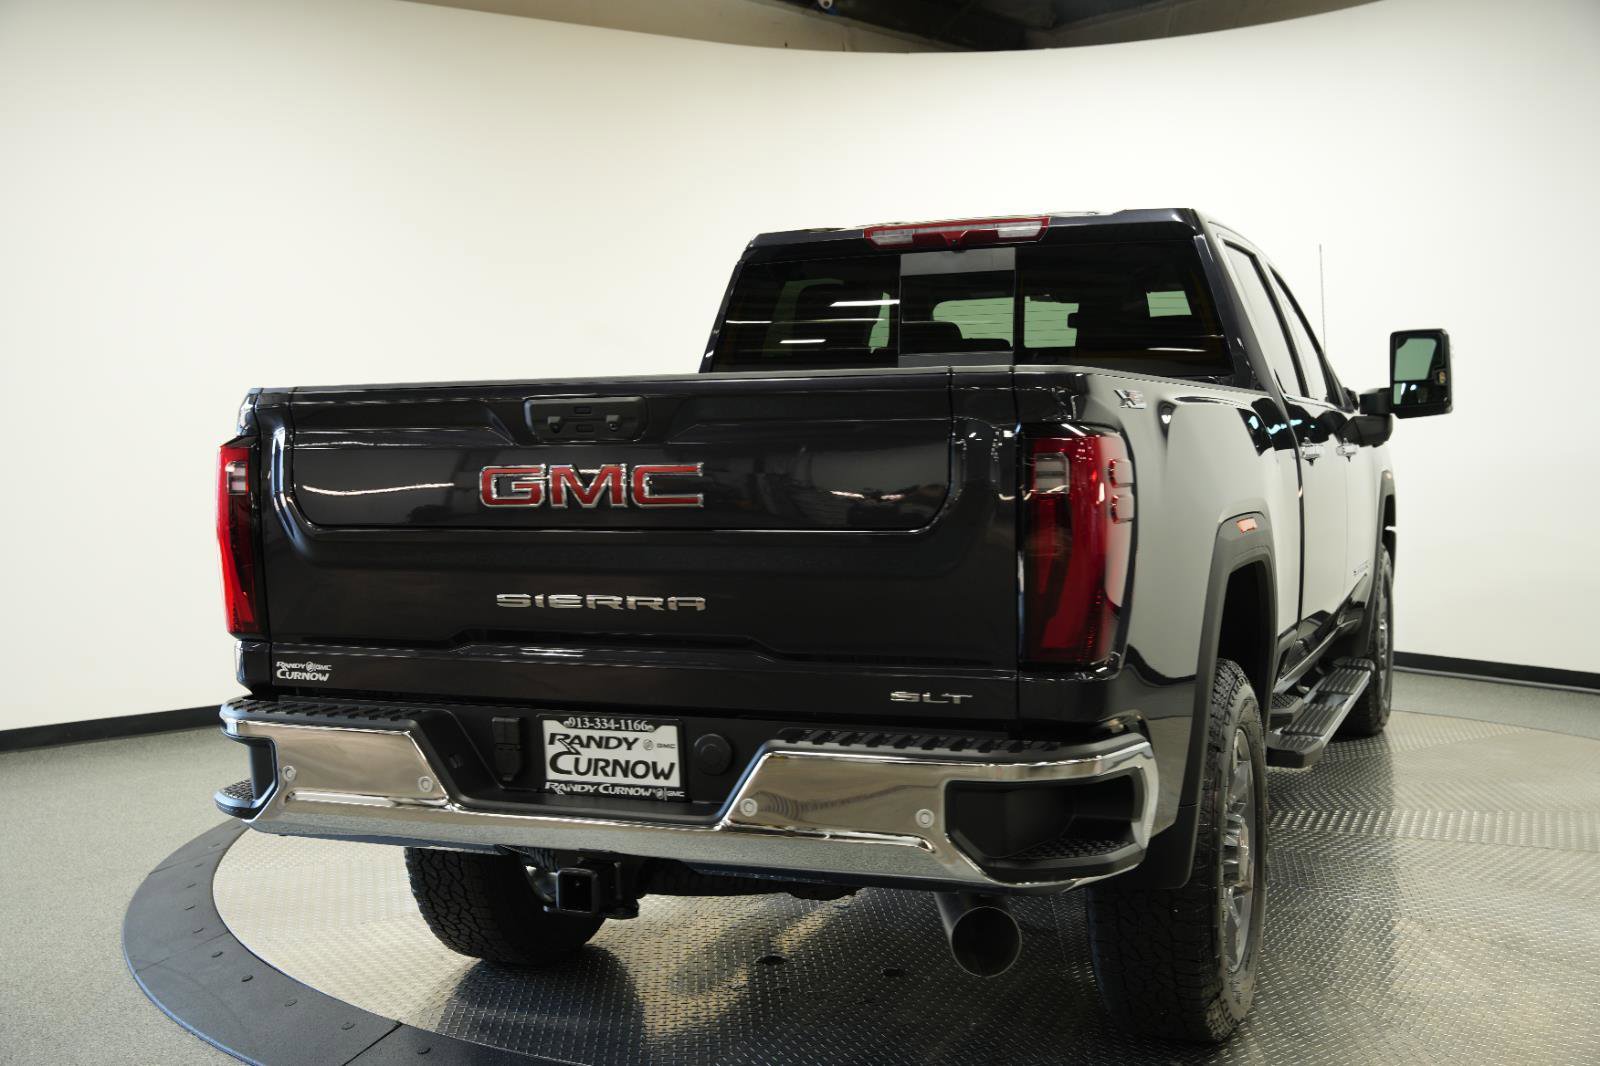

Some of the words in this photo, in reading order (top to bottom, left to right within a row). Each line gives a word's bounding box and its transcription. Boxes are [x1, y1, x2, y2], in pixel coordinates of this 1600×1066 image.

[479, 462, 704, 508] GMC
[496, 594, 706, 611] SIERRA
[276, 661, 305, 671] RANDY
[276, 668, 330, 681] CURNOW
[890, 691, 973, 704] SLT
[567, 716, 648, 731] 913-334-1166
[548, 732, 639, 755] RANDY
[550, 750, 676, 781] CURNOW
[544, 781, 598, 795] RANDY
[599, 783, 651, 797] CURNOW
